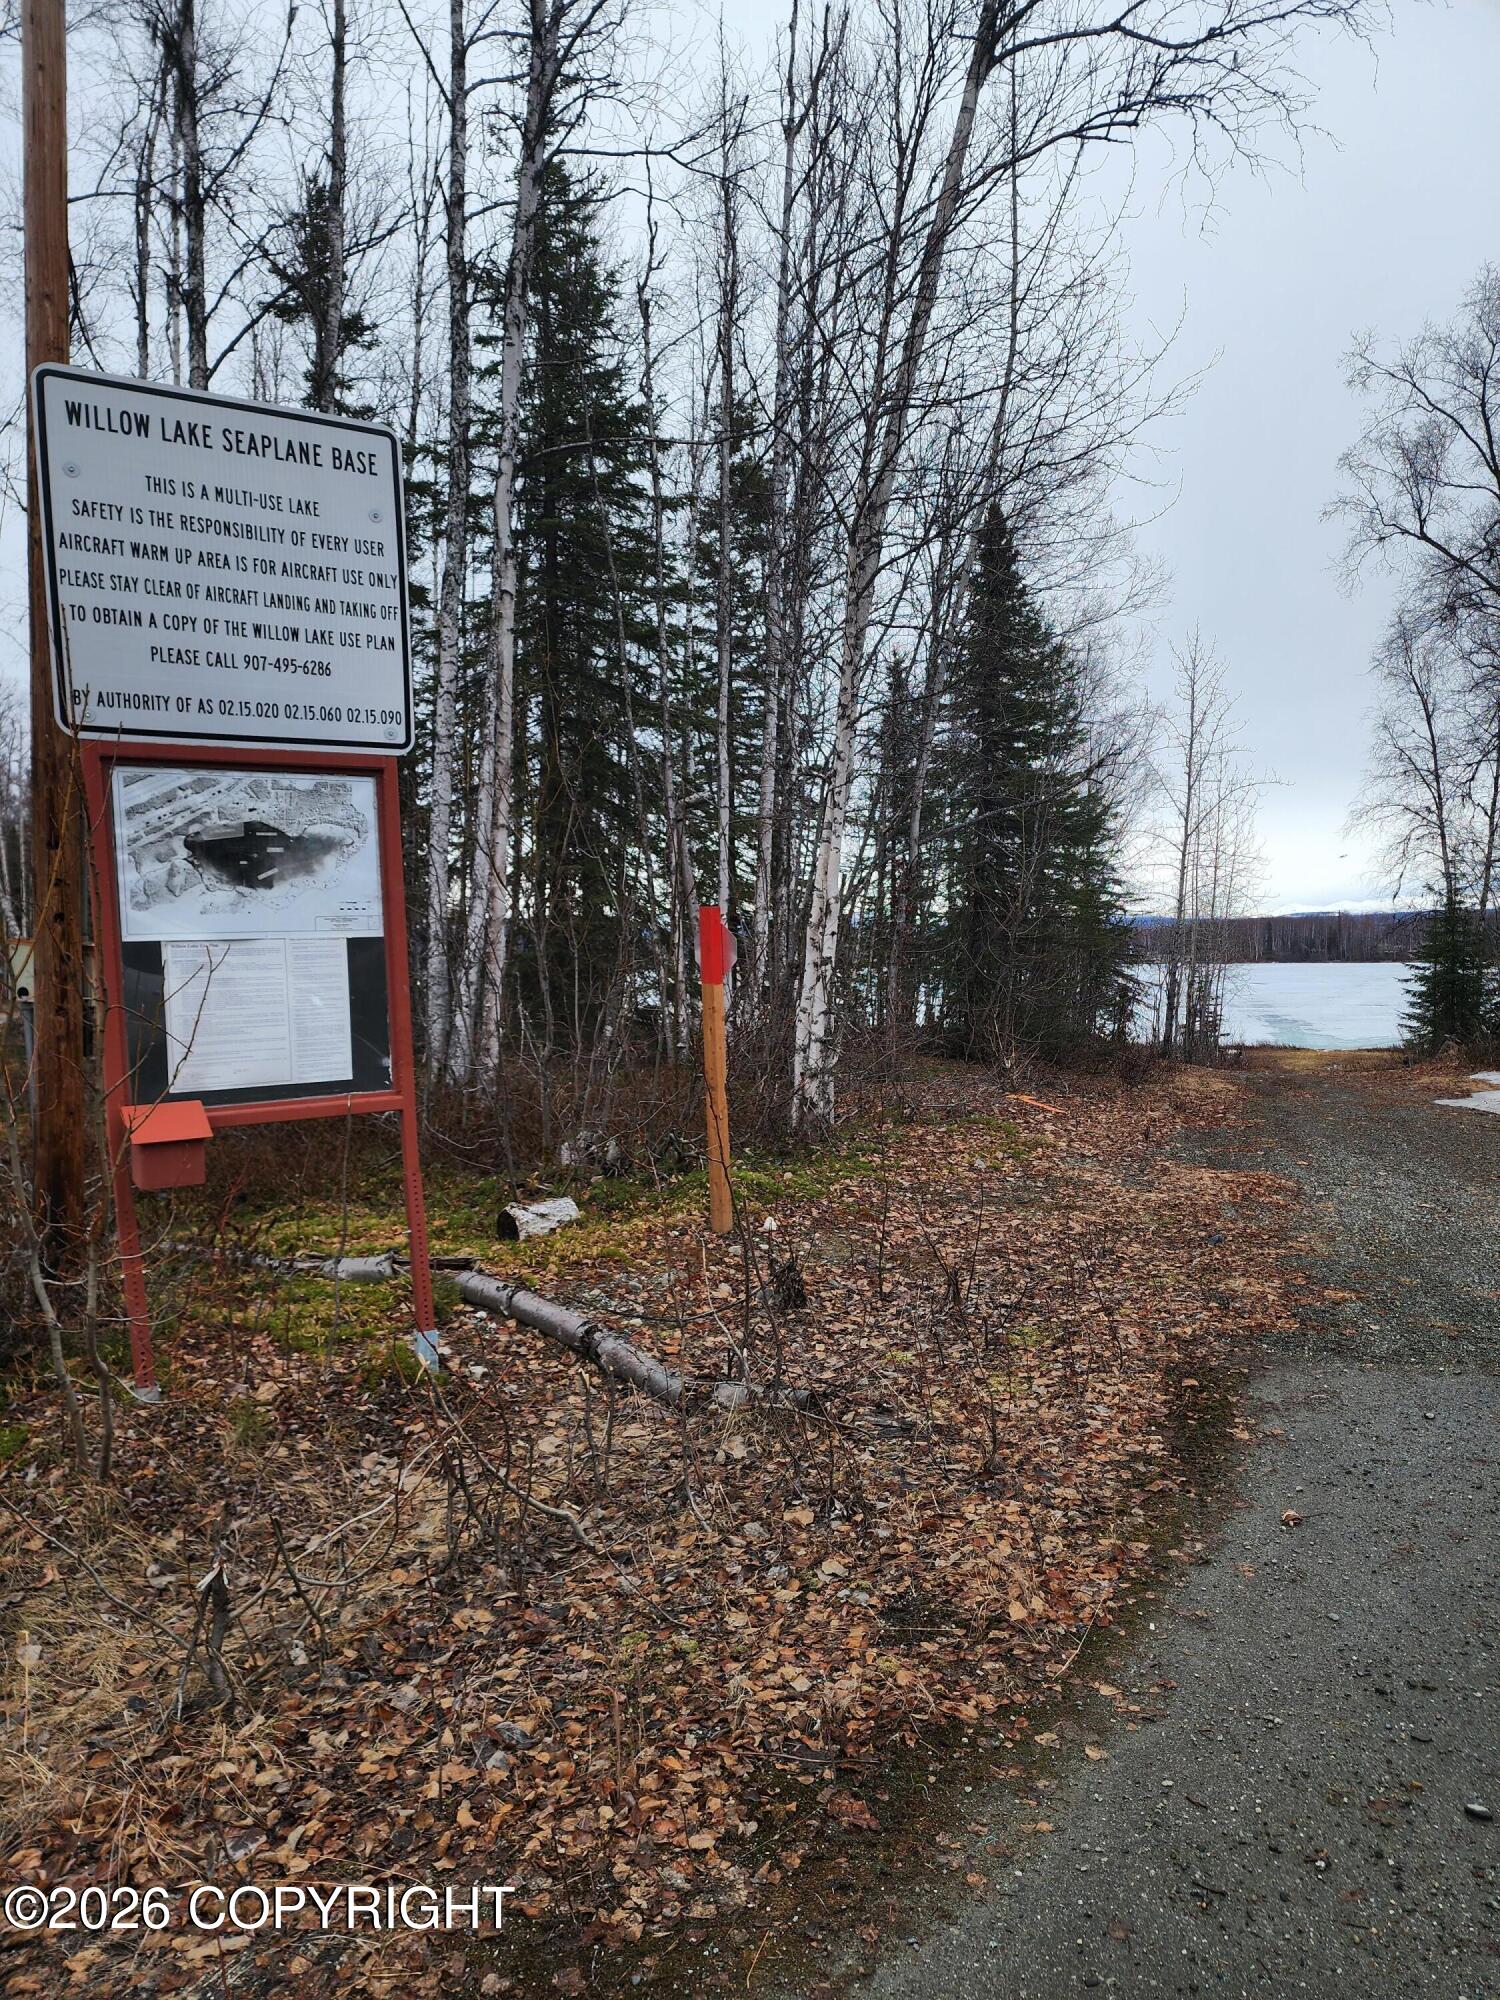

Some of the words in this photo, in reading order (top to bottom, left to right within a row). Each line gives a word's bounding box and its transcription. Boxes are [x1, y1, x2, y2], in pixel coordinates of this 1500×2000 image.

[65, 400, 150, 438] WILLOW
[161, 417, 213, 449] LAKE
[222, 428, 323, 467] SEAPLANE
[332, 447, 378, 476] BASE
[145, 475, 176, 495] THIS
[182, 481, 194, 498] IS
[201, 484, 209, 501] A
[214, 486, 283, 512] MULTI-USE
[289, 498, 320, 517] LAKE
[72, 499, 123, 522] SAFETY
[130, 507, 143, 524] IS
[148, 510, 174, 529] THE
[180, 514, 285, 544] RESPONSIBILITY
[291, 530, 306, 547] OF
[312, 533, 348, 552] EVERY
[354, 539, 384, 557] USER
[59, 532, 124, 556] AIRCRAFT
[130, 541, 168, 562] WARM
[175, 547, 192, 564] UP
[198, 551, 231, 570] AREA
[236, 555, 248, 572] IS
[253, 558, 276, 576] FOR
[281, 562, 337, 582] AIRCRAFT
[342, 569, 364, 586] USE
[369, 572, 397, 589] ONLY
[60, 568, 105, 590] PLEASE
[110, 574, 138, 593] STAY
[144, 578, 182, 598] CLEAR
[186, 583, 200, 600] OF
[206, 585, 258, 606] AIRCRAFT
[263, 592, 310, 612] LANDING
[315, 598, 336, 614] AND
[340, 600, 376, 619] TAKING
[381, 605, 398, 620] OFF
[69, 604, 86, 622] TO
[93, 606, 142, 627] OBTAIN
[149, 612, 158, 629] A
[163, 614, 197, 632] COPY
[204, 618, 219, 634] OF
[224, 620, 248, 638] THE
[252, 623, 299, 642] WILLOW
[305, 628, 334, 646] LAKE
[340, 632, 361, 648] USE
[366, 634, 395, 651] PLAN
[150, 646, 200, 666] PLEASE
[206, 651, 238, 669] CALL
[244, 654, 331, 676] 907-495-6286
[73, 689, 90, 707] BY
[97, 691, 170, 711] AUTHORITY
[176, 697, 192, 712] OF
[198, 698, 213, 714] AS
[219, 700, 279, 718] 02.15.020
[284, 704, 342, 722] 02.15.060
[347, 708, 401, 725] 02.15.090
